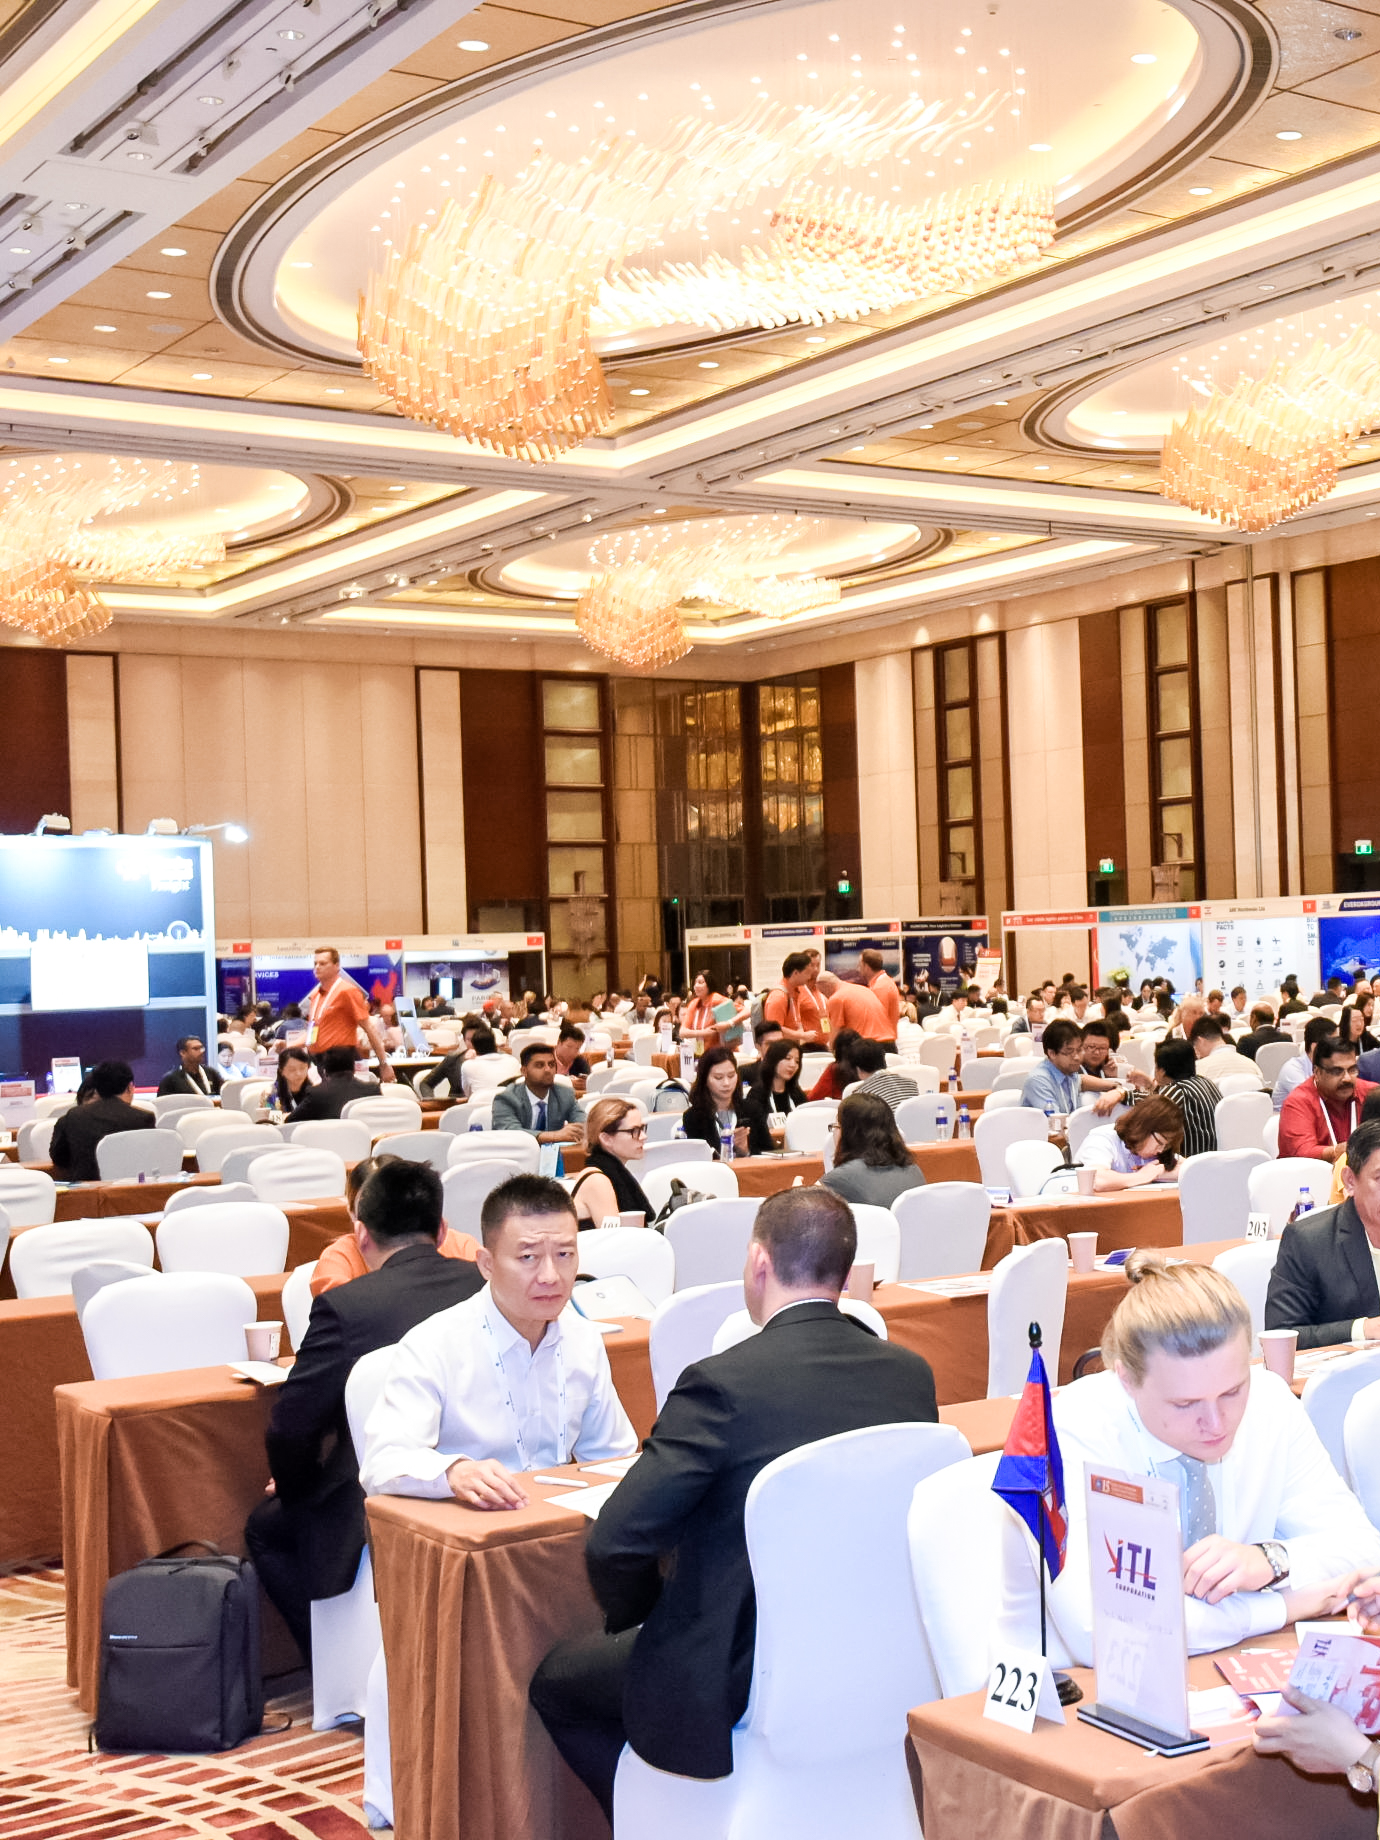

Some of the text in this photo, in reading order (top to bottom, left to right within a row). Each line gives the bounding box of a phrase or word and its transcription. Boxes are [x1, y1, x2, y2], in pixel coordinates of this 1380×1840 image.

[1247, 1220, 1267, 1237] 203
[1115, 1582, 1156, 1601] CORPORATION
[990, 1662, 1038, 1712] 223
